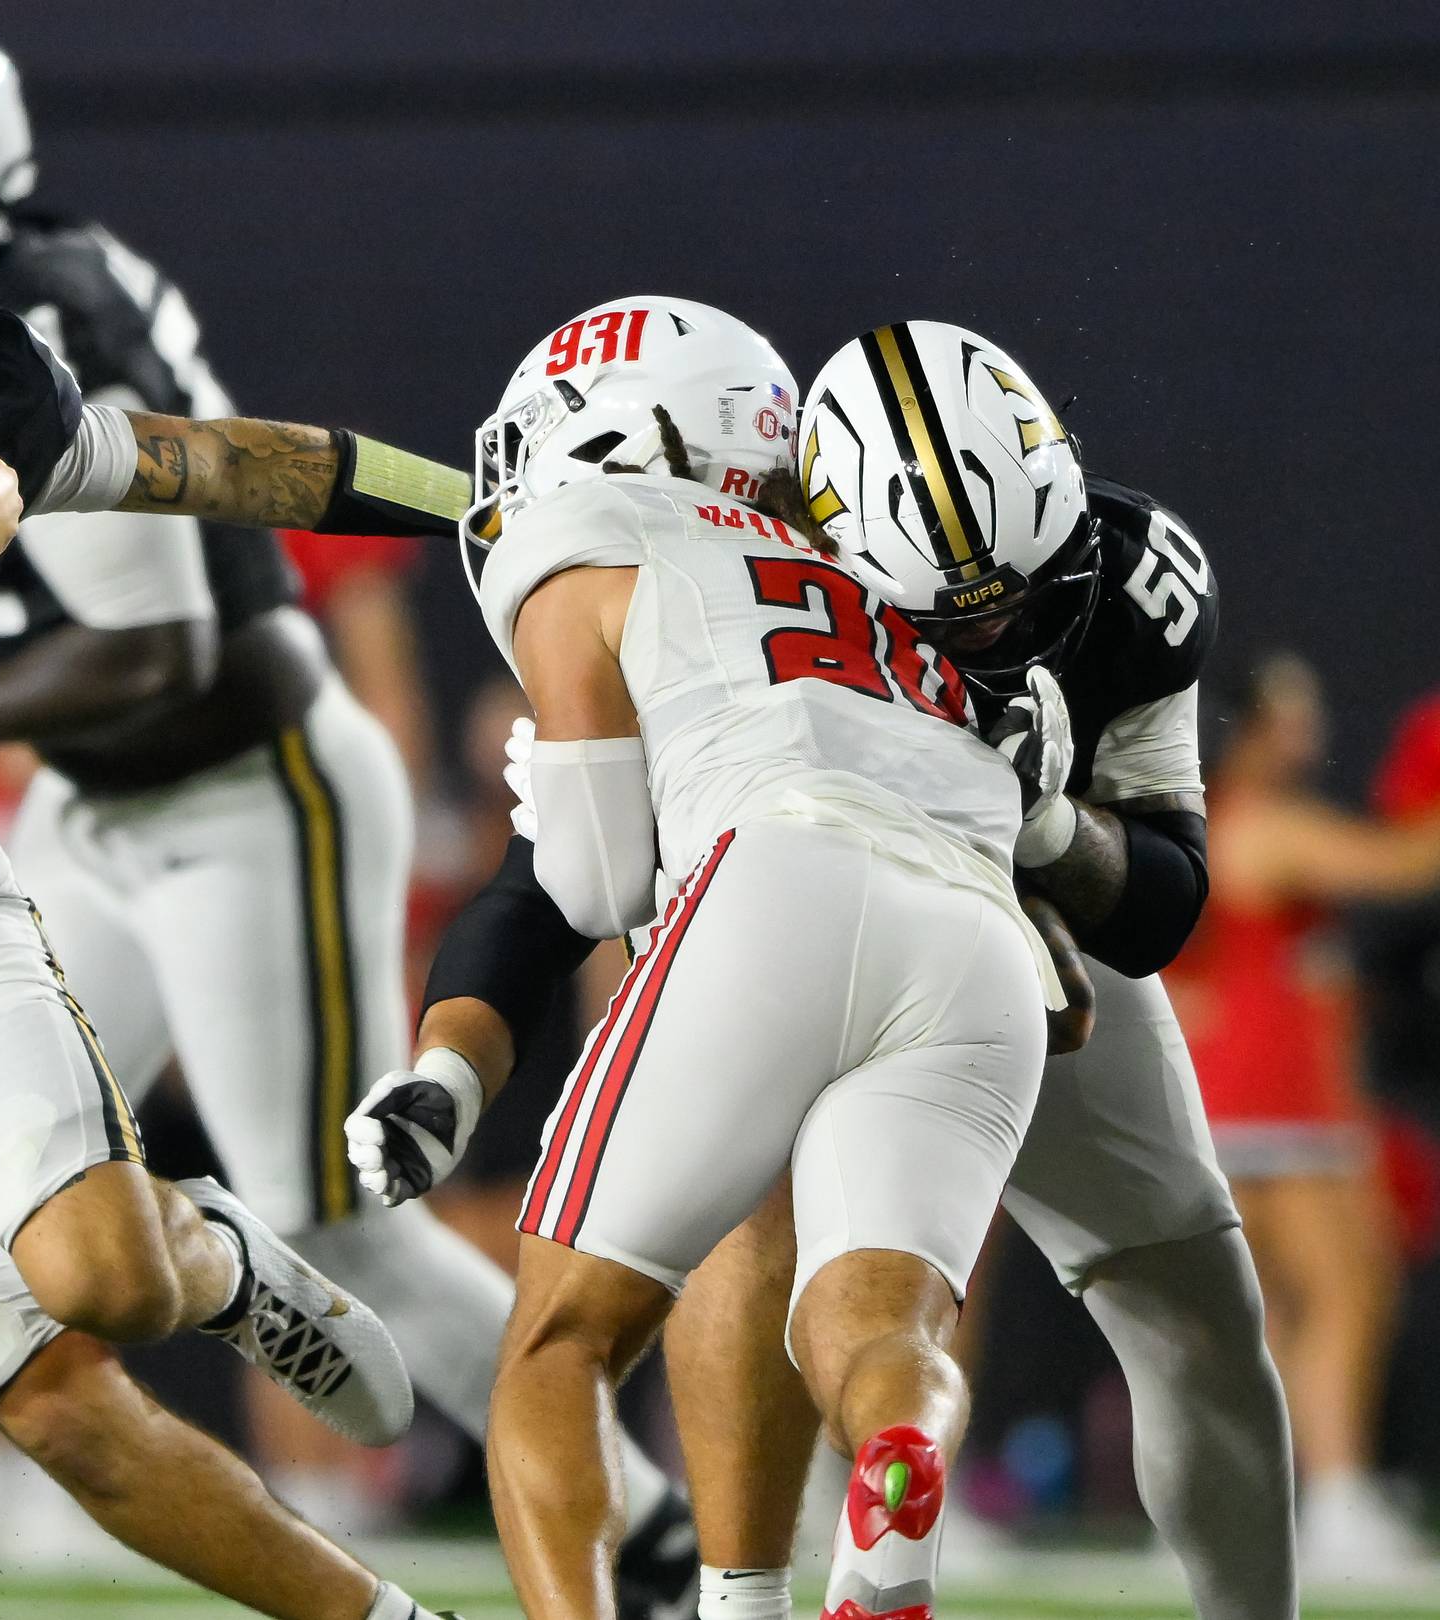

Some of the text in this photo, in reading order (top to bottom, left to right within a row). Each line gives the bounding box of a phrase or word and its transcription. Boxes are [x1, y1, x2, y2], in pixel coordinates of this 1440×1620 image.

[545, 309, 650, 376] 931
[952, 581, 1005, 608] VUFB
[1122, 510, 1208, 647] 50
